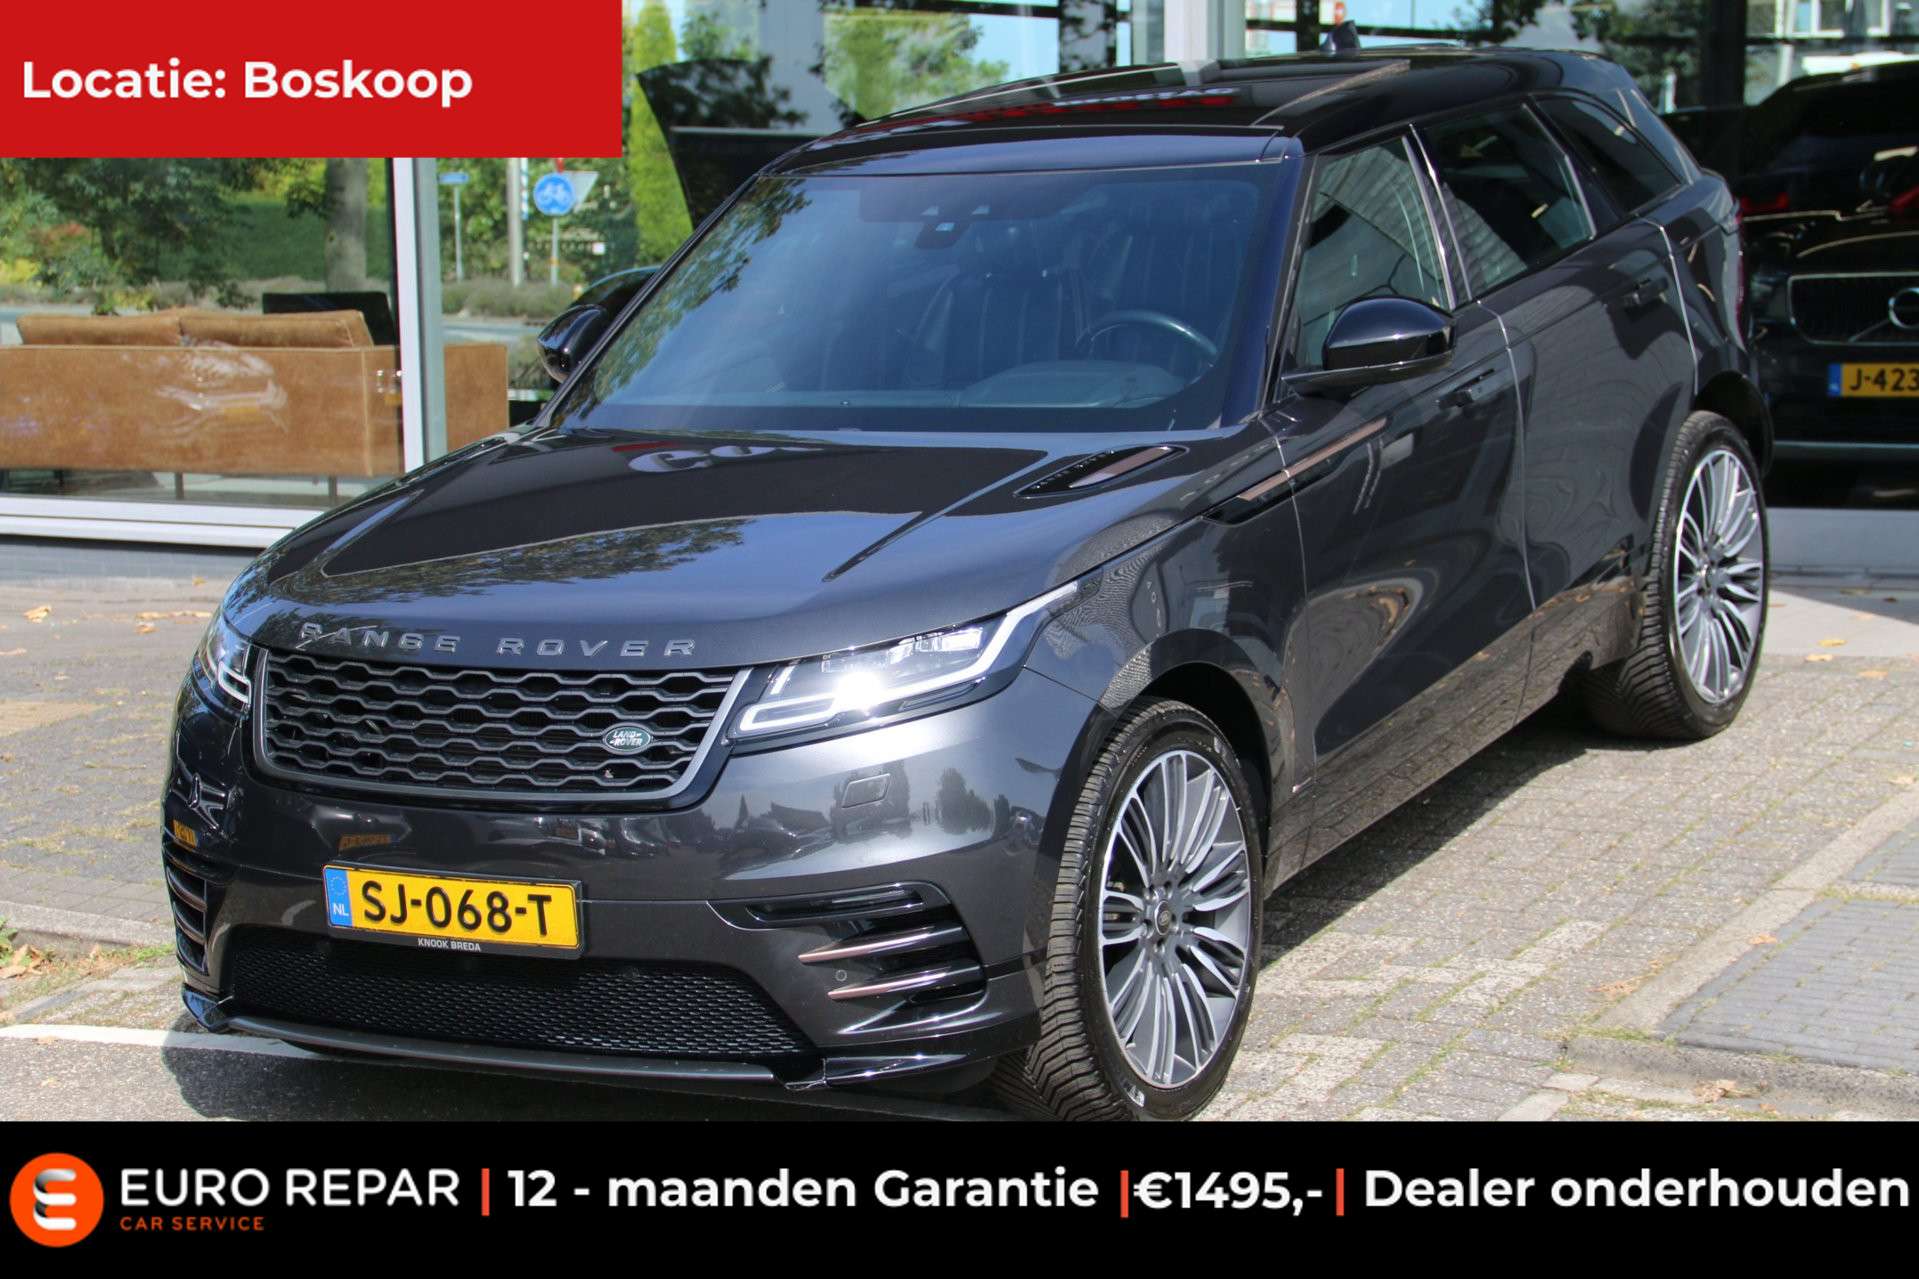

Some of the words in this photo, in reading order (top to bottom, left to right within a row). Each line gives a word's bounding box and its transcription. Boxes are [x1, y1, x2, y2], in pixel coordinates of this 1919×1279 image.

[300, 622, 461, 654] RANGE
[496, 637, 697, 657] ROVER
[614, 738, 642, 746] ROVER
[333, 903, 349, 916] NL
[361, 880, 552, 936] SJ-068-T
[417, 937, 448, 949] KNOOK
[450, 940, 481, 952] BREDA
